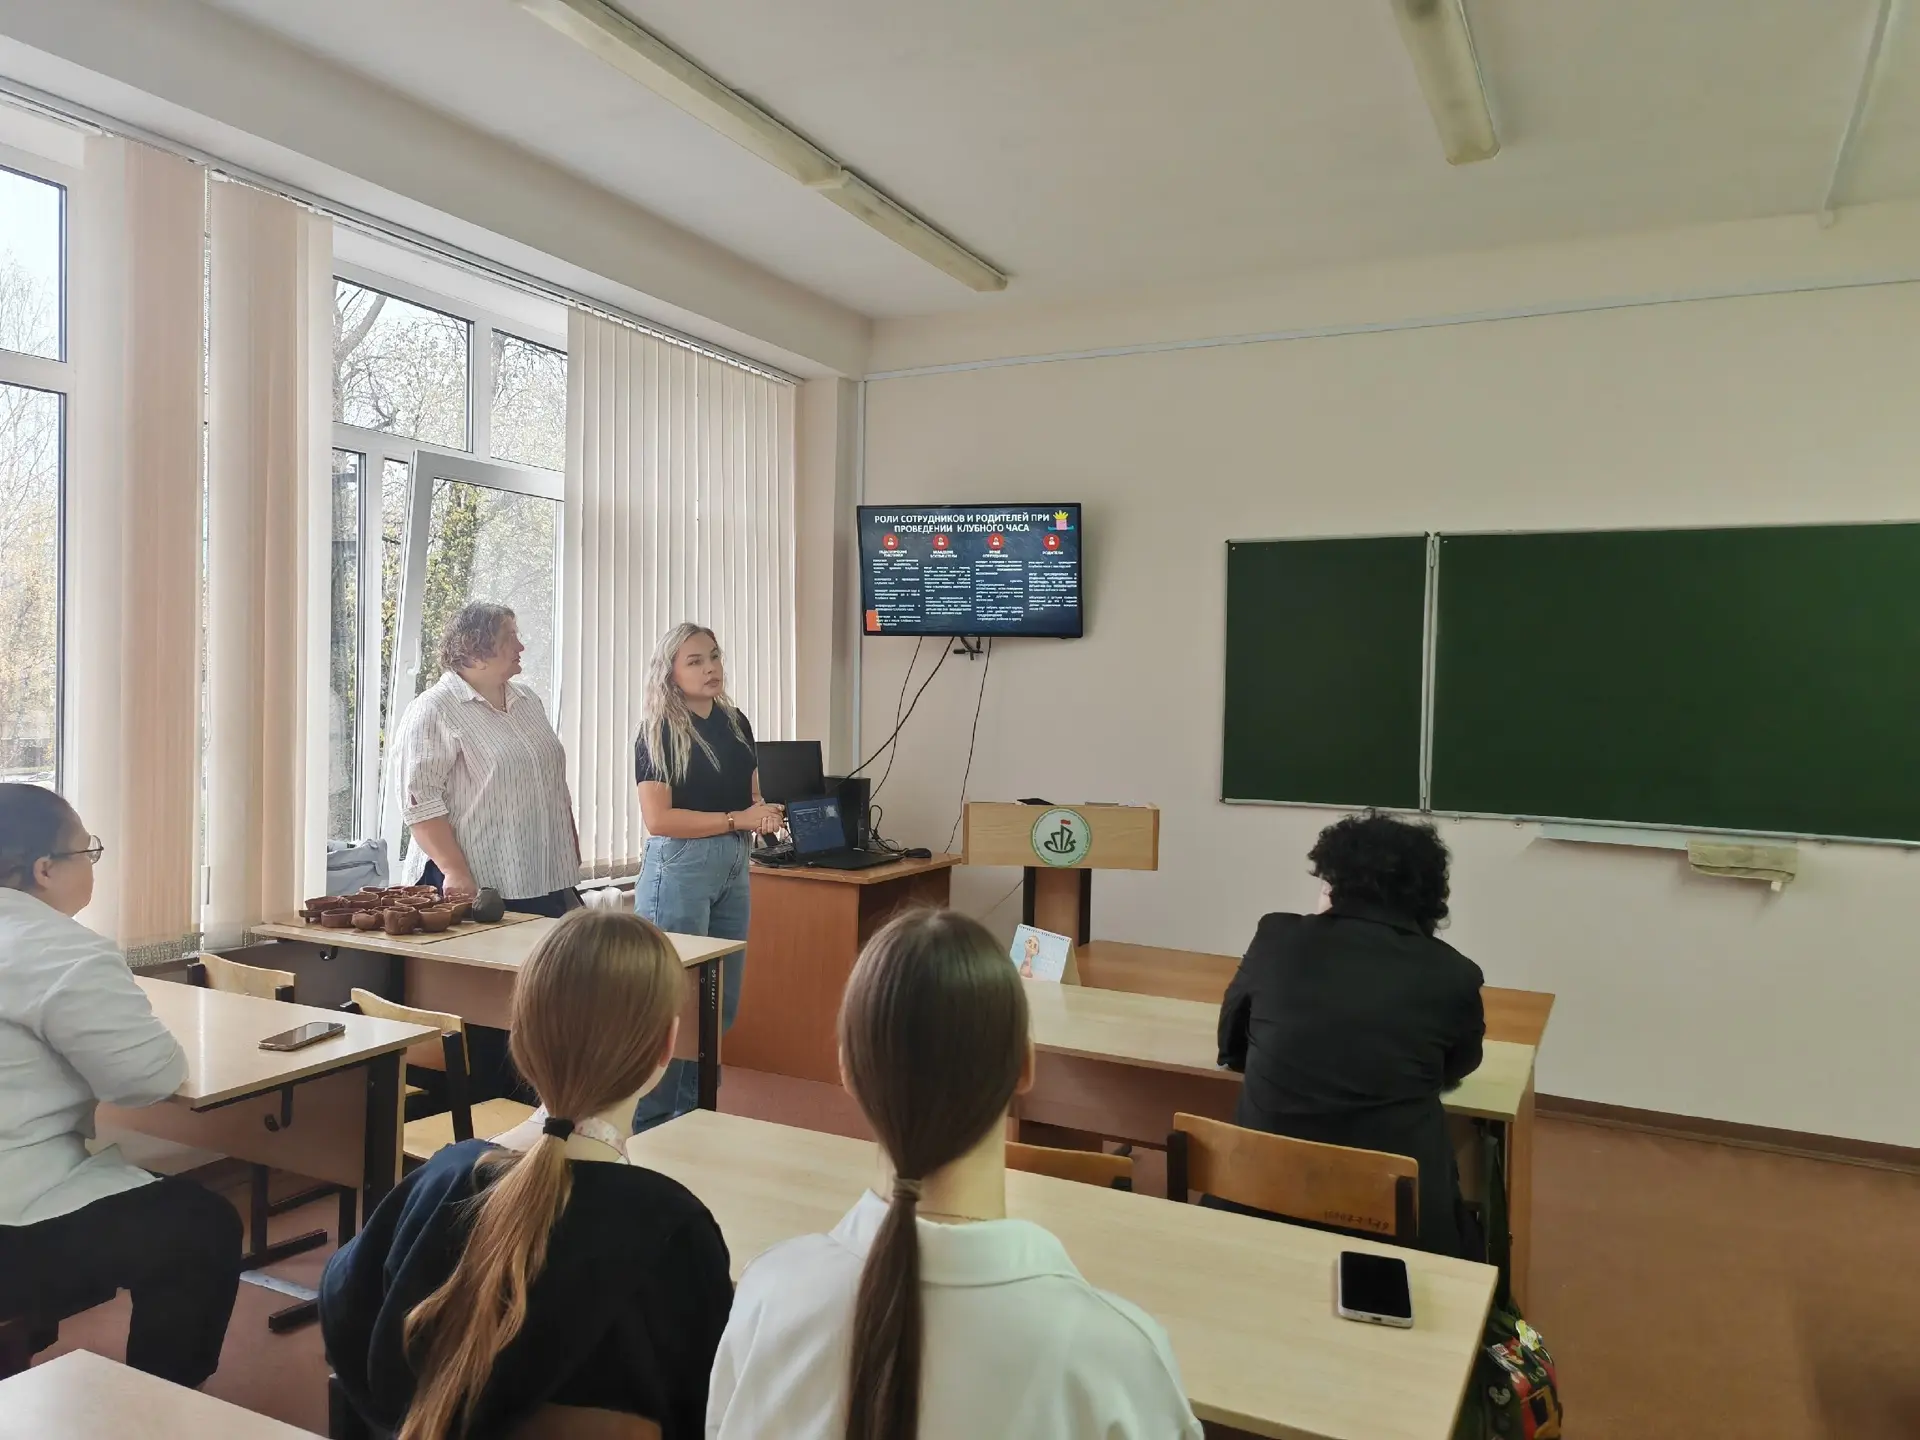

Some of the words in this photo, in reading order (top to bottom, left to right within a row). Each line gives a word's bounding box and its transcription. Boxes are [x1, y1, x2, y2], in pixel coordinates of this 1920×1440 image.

[874, 515, 899, 523] РОЛИ
[900, 514, 965, 524] СОТРУДНИКОВ
[967, 514, 974, 522] И
[975, 512, 1029, 523] РОДИТЕЛЕЙ
[1031, 514, 1050, 522] ПРИ
[894, 524, 953, 534] ПРОВЕДЕНИИ
[957, 523, 1004, 532] КЛУБНОГО
[1005, 523, 1030, 532] ЧАСА
